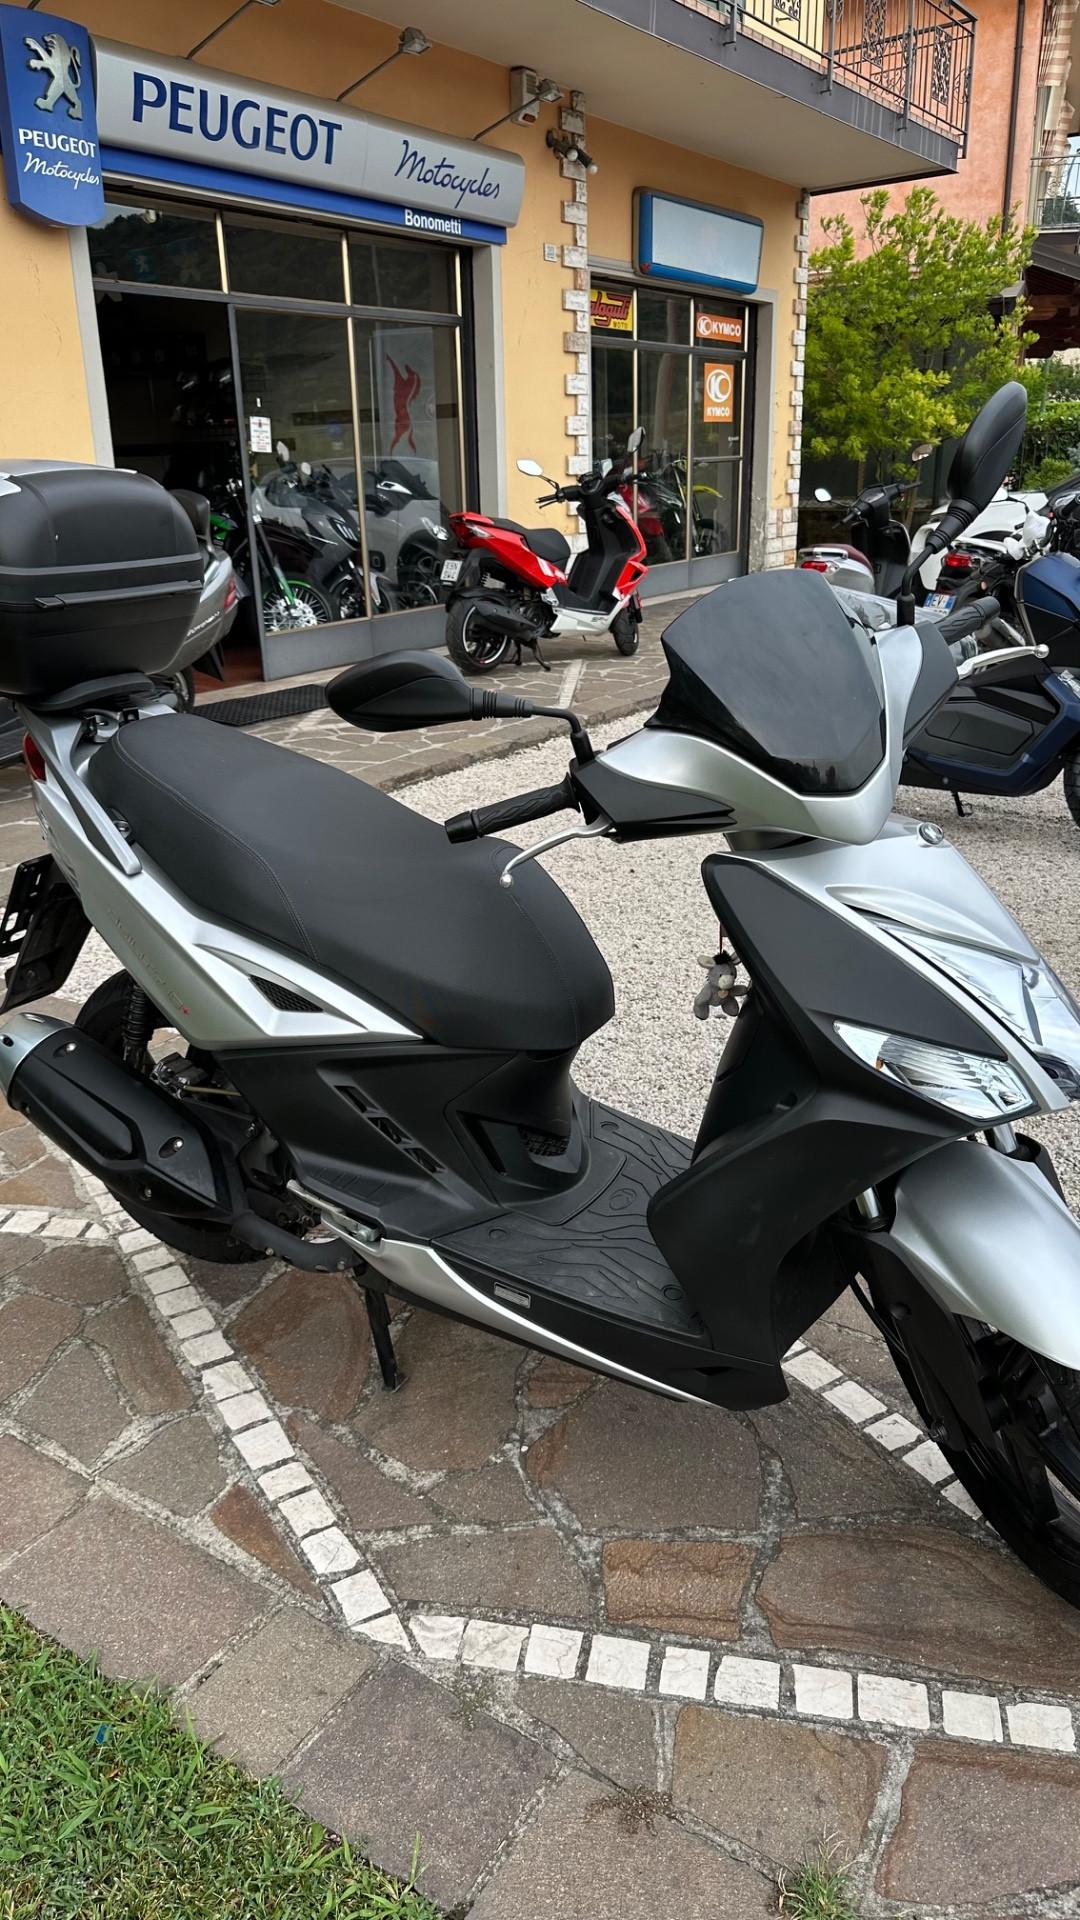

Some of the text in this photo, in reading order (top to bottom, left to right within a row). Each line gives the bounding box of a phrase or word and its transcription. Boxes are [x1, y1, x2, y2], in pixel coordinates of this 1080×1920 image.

[18, 128, 96, 158] PEUGEOT
[133, 72, 500, 209] PEUGEOT Motocycles
[23, 152, 100, 190] Motocycles
[404, 208, 462, 235] Bonometti
[712, 321, 742, 337] KYMCO
[706, 407, 730, 417] KYMCO
